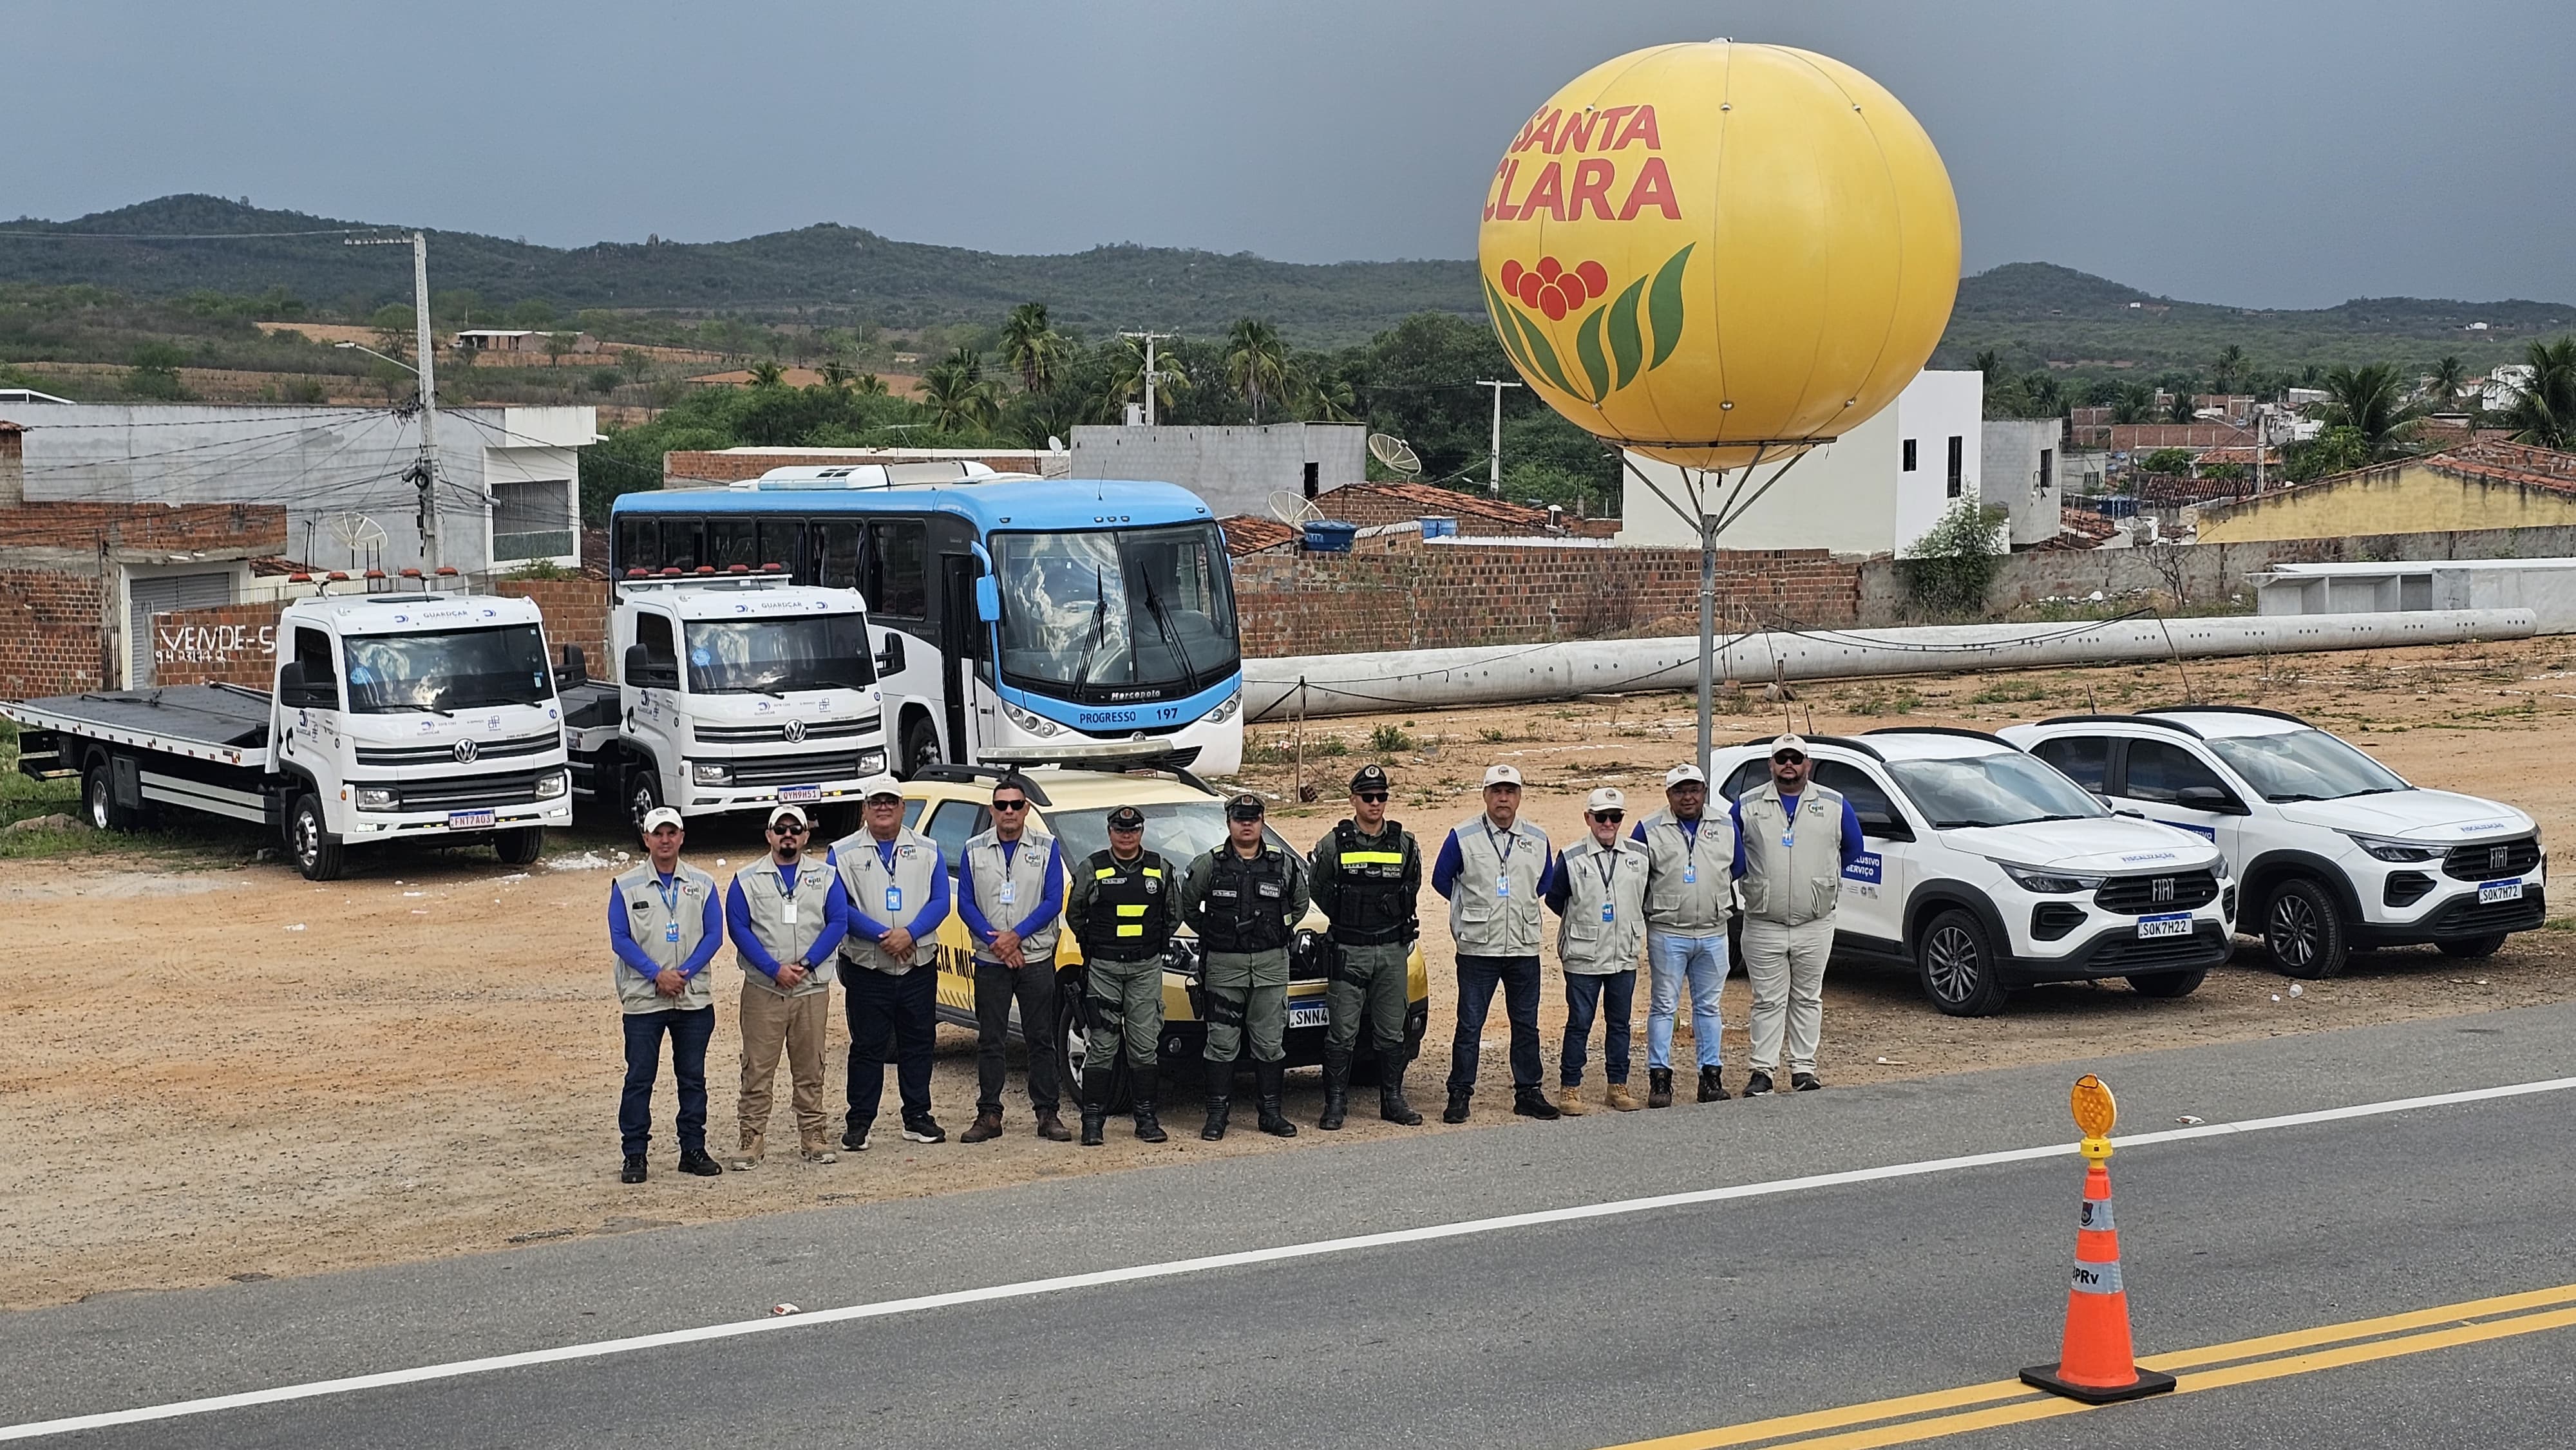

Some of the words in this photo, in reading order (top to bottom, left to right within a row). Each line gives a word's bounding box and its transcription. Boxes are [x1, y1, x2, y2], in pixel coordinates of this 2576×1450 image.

[1510, 105, 1662, 155] SANTA
[1483, 157, 1682, 222] CLARA
[160, 625, 279, 654] VENDE-S
[1110, 690, 1160, 701] Marcopolo
[1079, 711, 1136, 724] PROGRESSO
[1157, 708, 1178, 720] 197
[455, 814, 491, 827] FNT7A03
[2489, 845, 2509, 869] FIAT
[2152, 878, 2175, 902] FIAT
[2483, 885, 2518, 901] SOK7H72
[2143, 920, 2186, 936] SOK7H22
